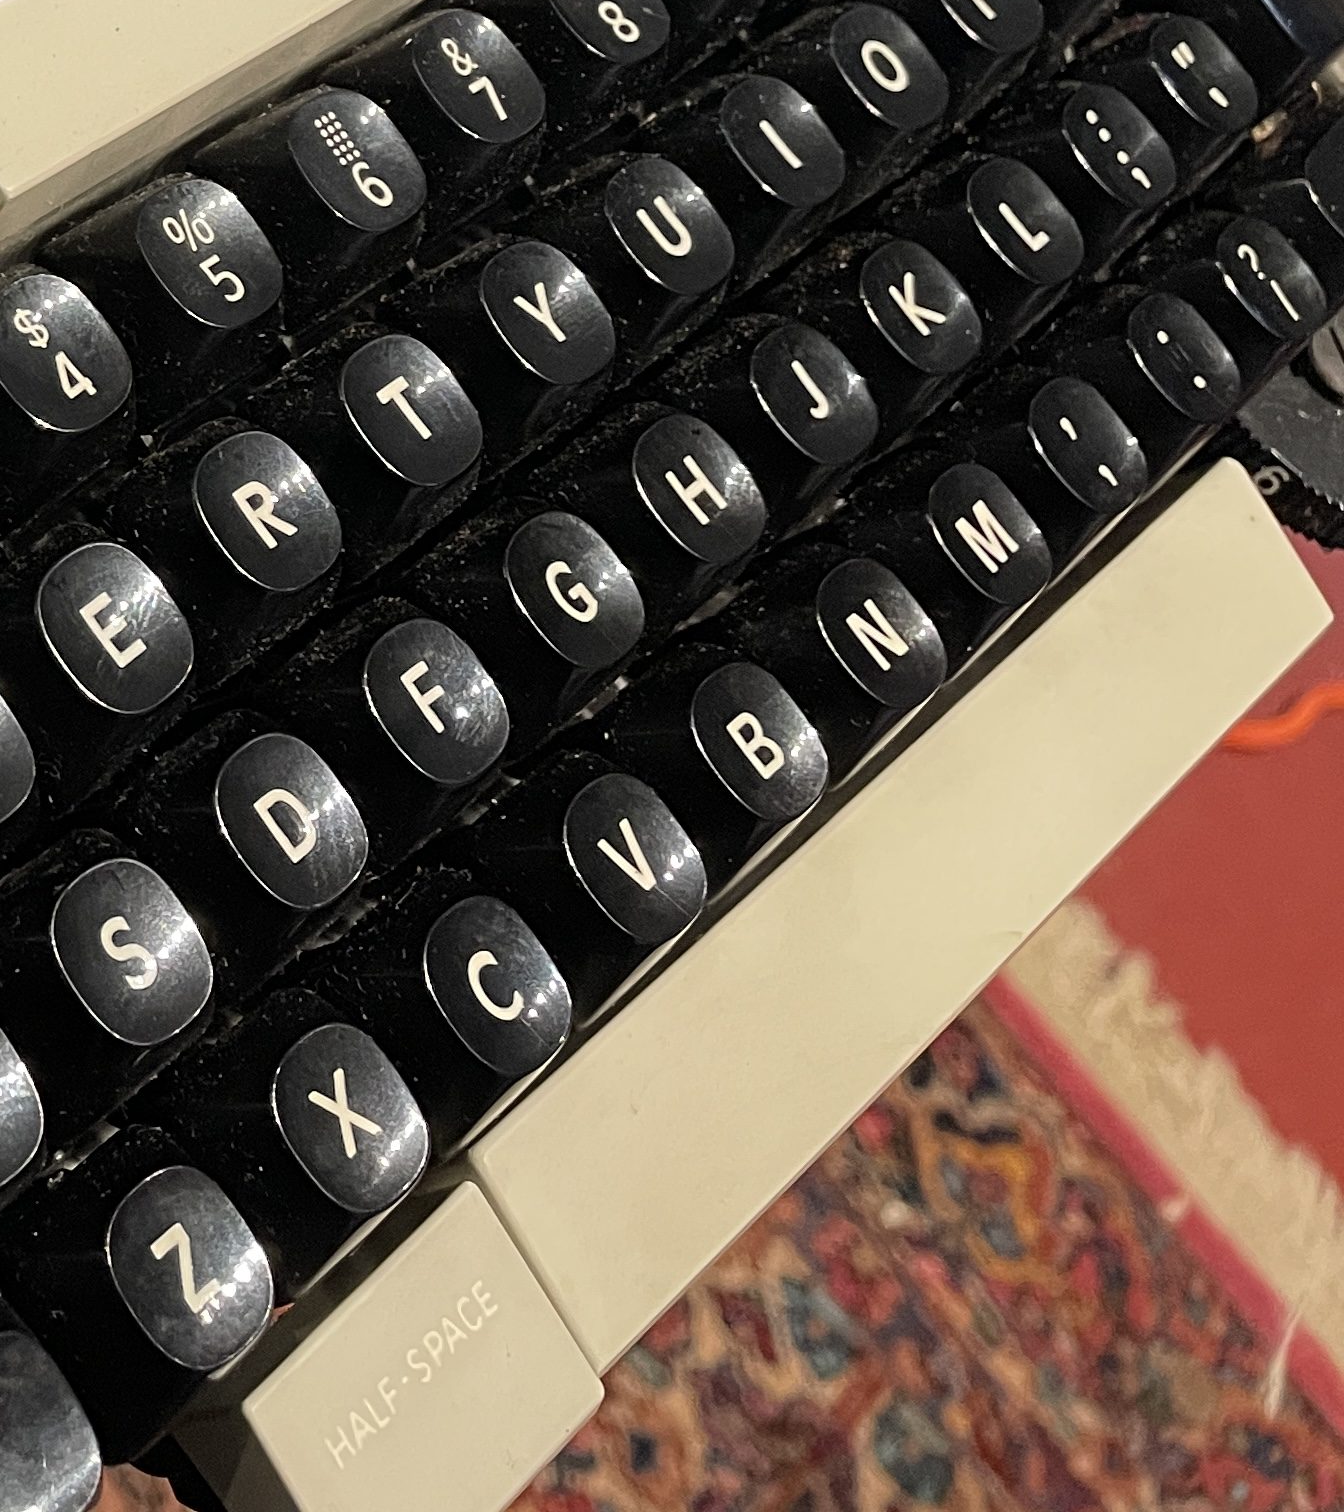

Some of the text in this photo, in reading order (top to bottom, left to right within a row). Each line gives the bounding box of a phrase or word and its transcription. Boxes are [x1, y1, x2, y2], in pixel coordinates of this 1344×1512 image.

[597, 0, 640, 44] 8
[467, 76, 508, 122] 7
[860, 39, 910, 93] O
[758, 118, 804, 170] I
[351, 161, 394, 208] 6
[635, 194, 693, 258] U
[998, 202, 1051, 252] L
[198, 253, 246, 303] 5
[888, 271, 947, 337] K
[513, 281, 567, 343] Y
[53, 350, 97, 400] 4
[375, 374, 433, 441] T
[791, 359, 830, 420] J
[231, 480, 299, 550] R
[664, 454, 729, 525] H
[954, 498, 1020, 574] M
[544, 560, 599, 623] G
[78, 590, 148, 670] E
[845, 598, 910, 672] N
[399, 660, 446, 734] F
[725, 711, 786, 780] B
[253, 788, 318, 864] D
[596, 817, 657, 892] V
[99, 915, 159, 991] S
[467, 950, 525, 1021] C
[308, 1068, 382, 1159] X
[148, 1221, 220, 1315] Z
